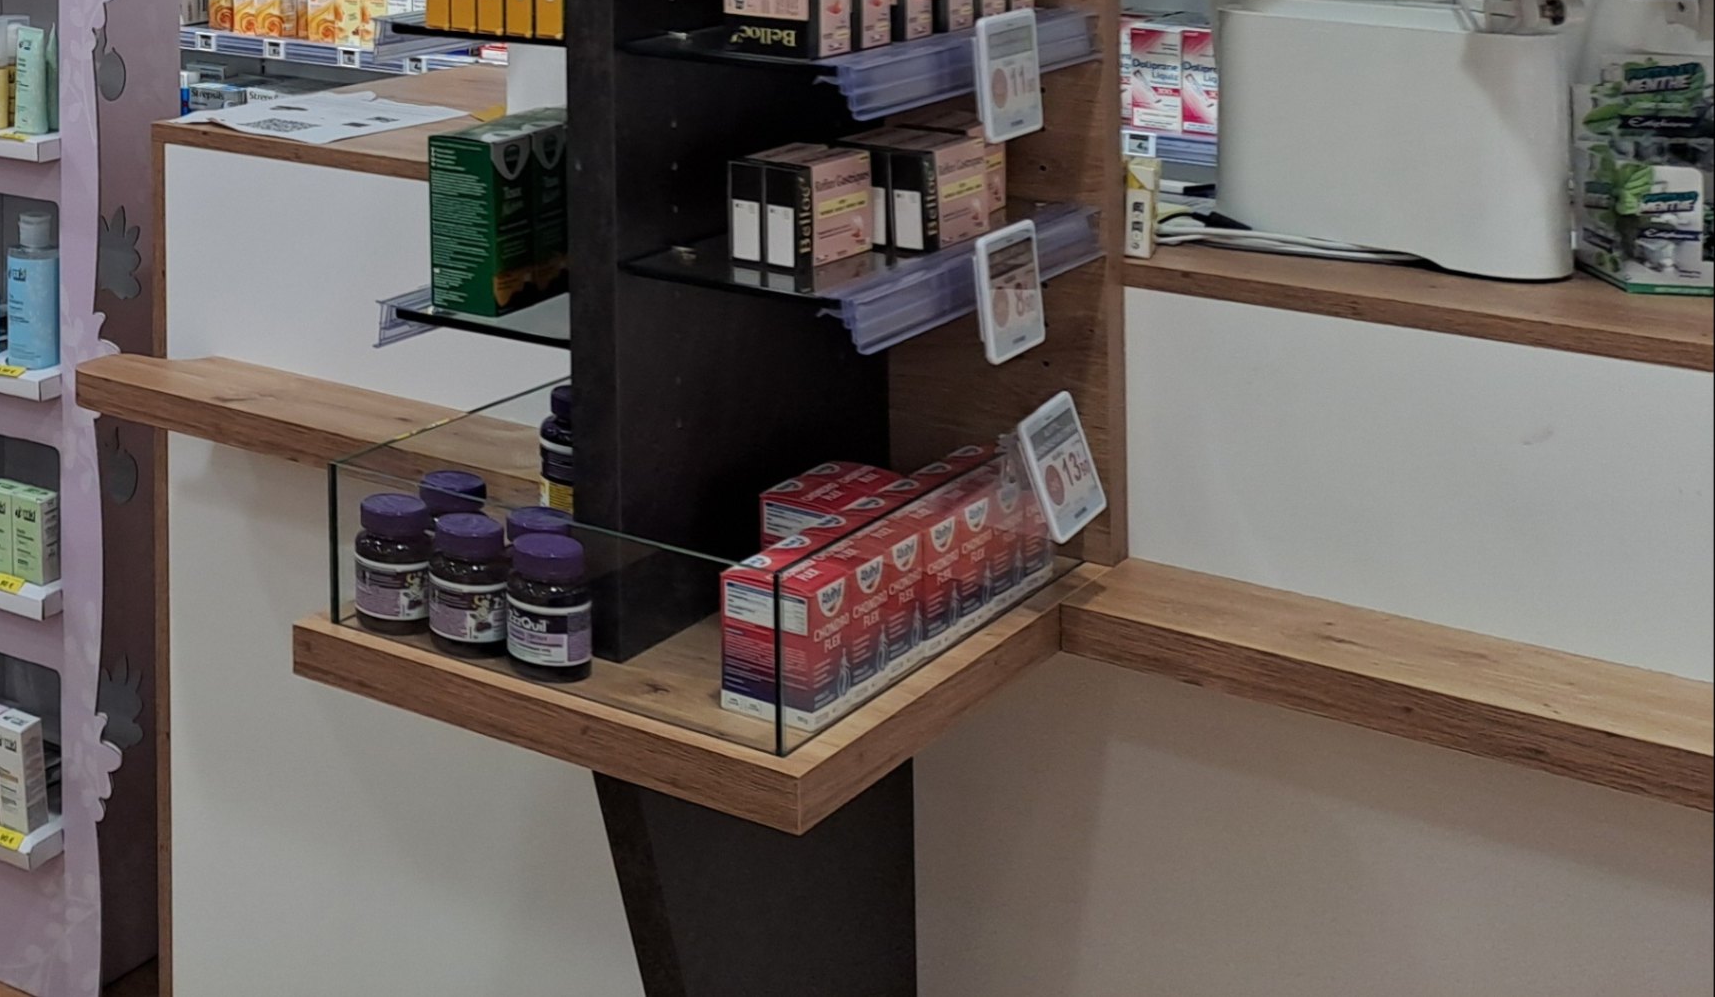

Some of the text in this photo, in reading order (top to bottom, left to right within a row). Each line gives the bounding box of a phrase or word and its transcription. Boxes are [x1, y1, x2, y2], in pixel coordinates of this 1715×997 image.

[1132, 58, 1178, 71] Doliprane
[1622, 73, 1691, 95] MENTHE
[927, 549, 959, 576] CHONDRO
[888, 568, 923, 596] CHONDRO
[936, 569, 952, 584] FLEX
[853, 590, 888, 619] CHONDRO
[898, 590, 915, 605] FLEX
[814, 613, 849, 643] CHONDRO
[863, 613, 880, 629] FLEX
[824, 637, 841, 653] FLEX
